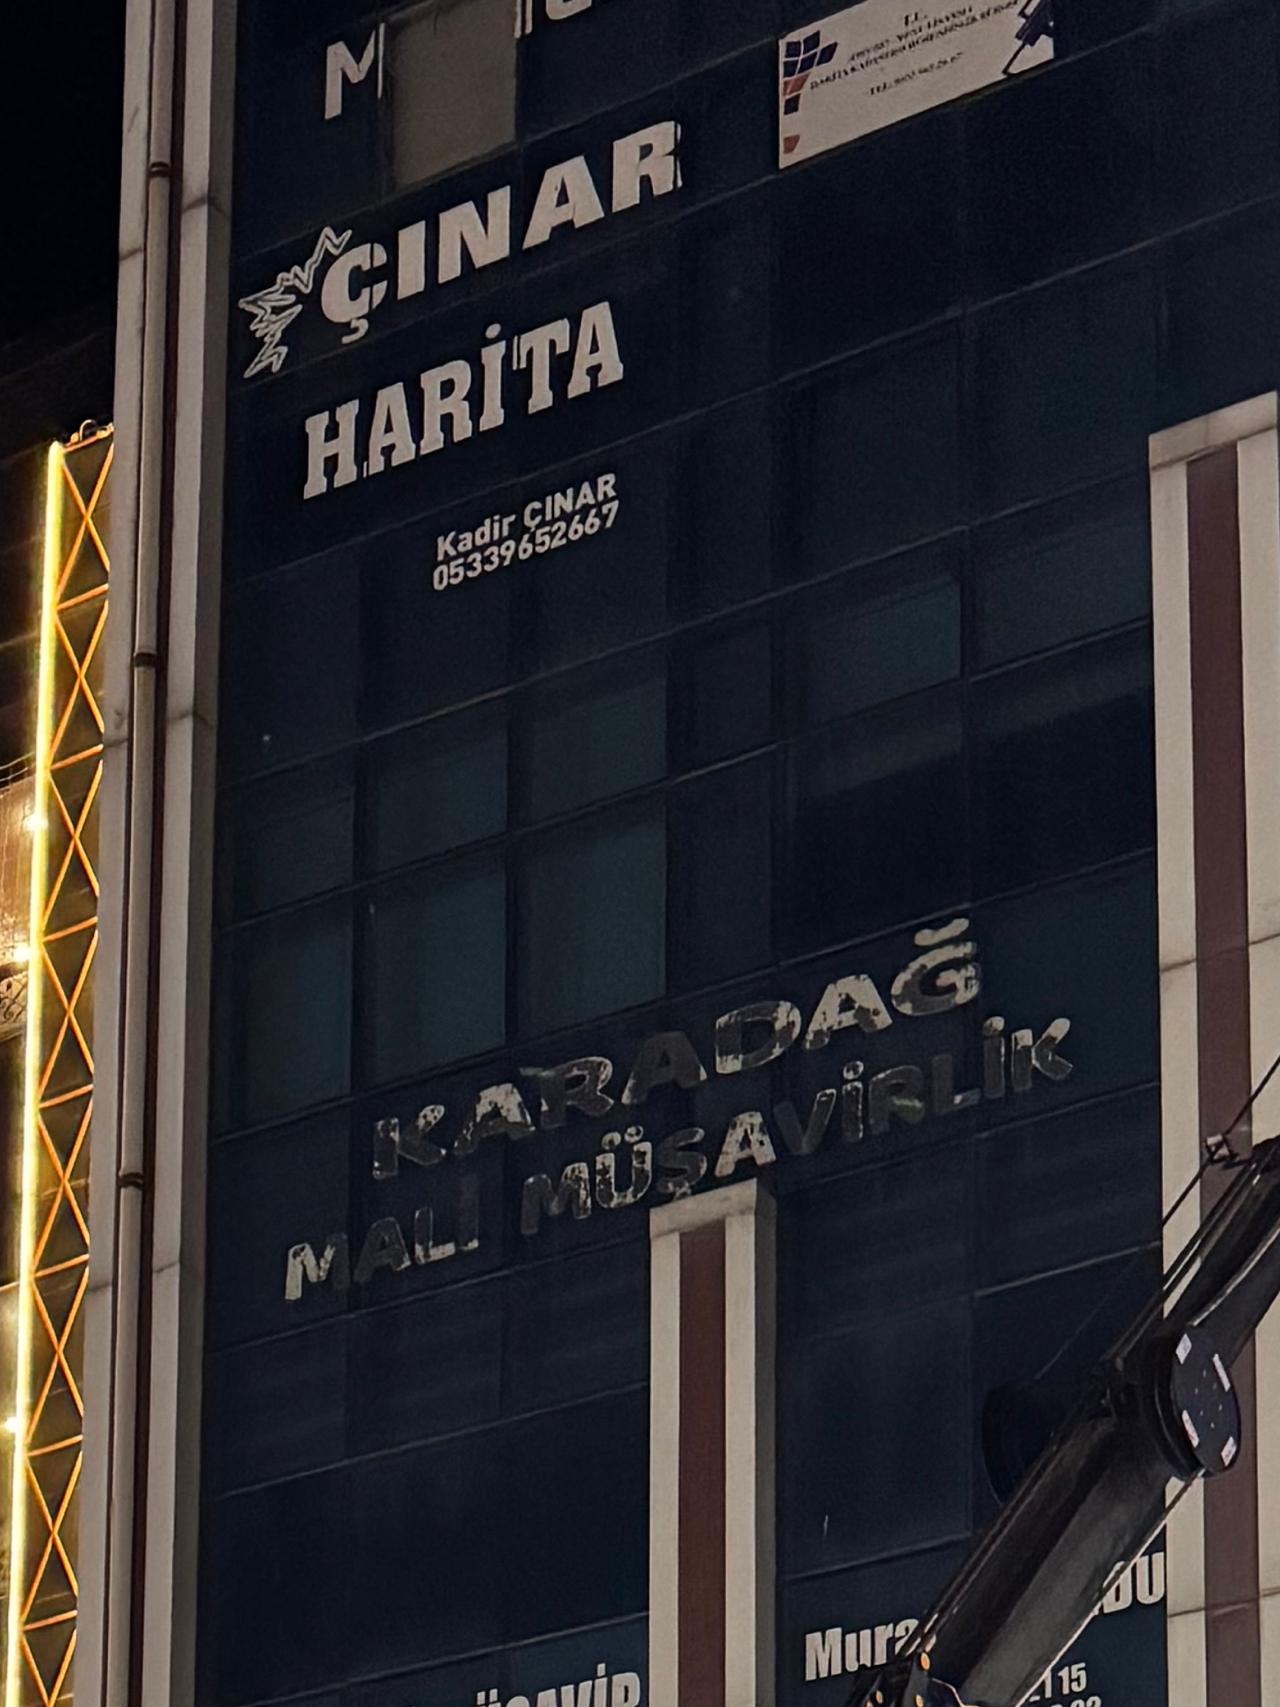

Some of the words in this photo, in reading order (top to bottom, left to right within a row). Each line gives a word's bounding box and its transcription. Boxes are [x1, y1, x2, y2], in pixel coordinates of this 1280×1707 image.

[321, 120, 682, 344] ÇINAR
[302, 301, 624, 500] HARİTA
[432, 501, 619, 592] 05339652667
[436, 510, 517, 561] Kadir
[522, 473, 618, 535] ÇINAR
